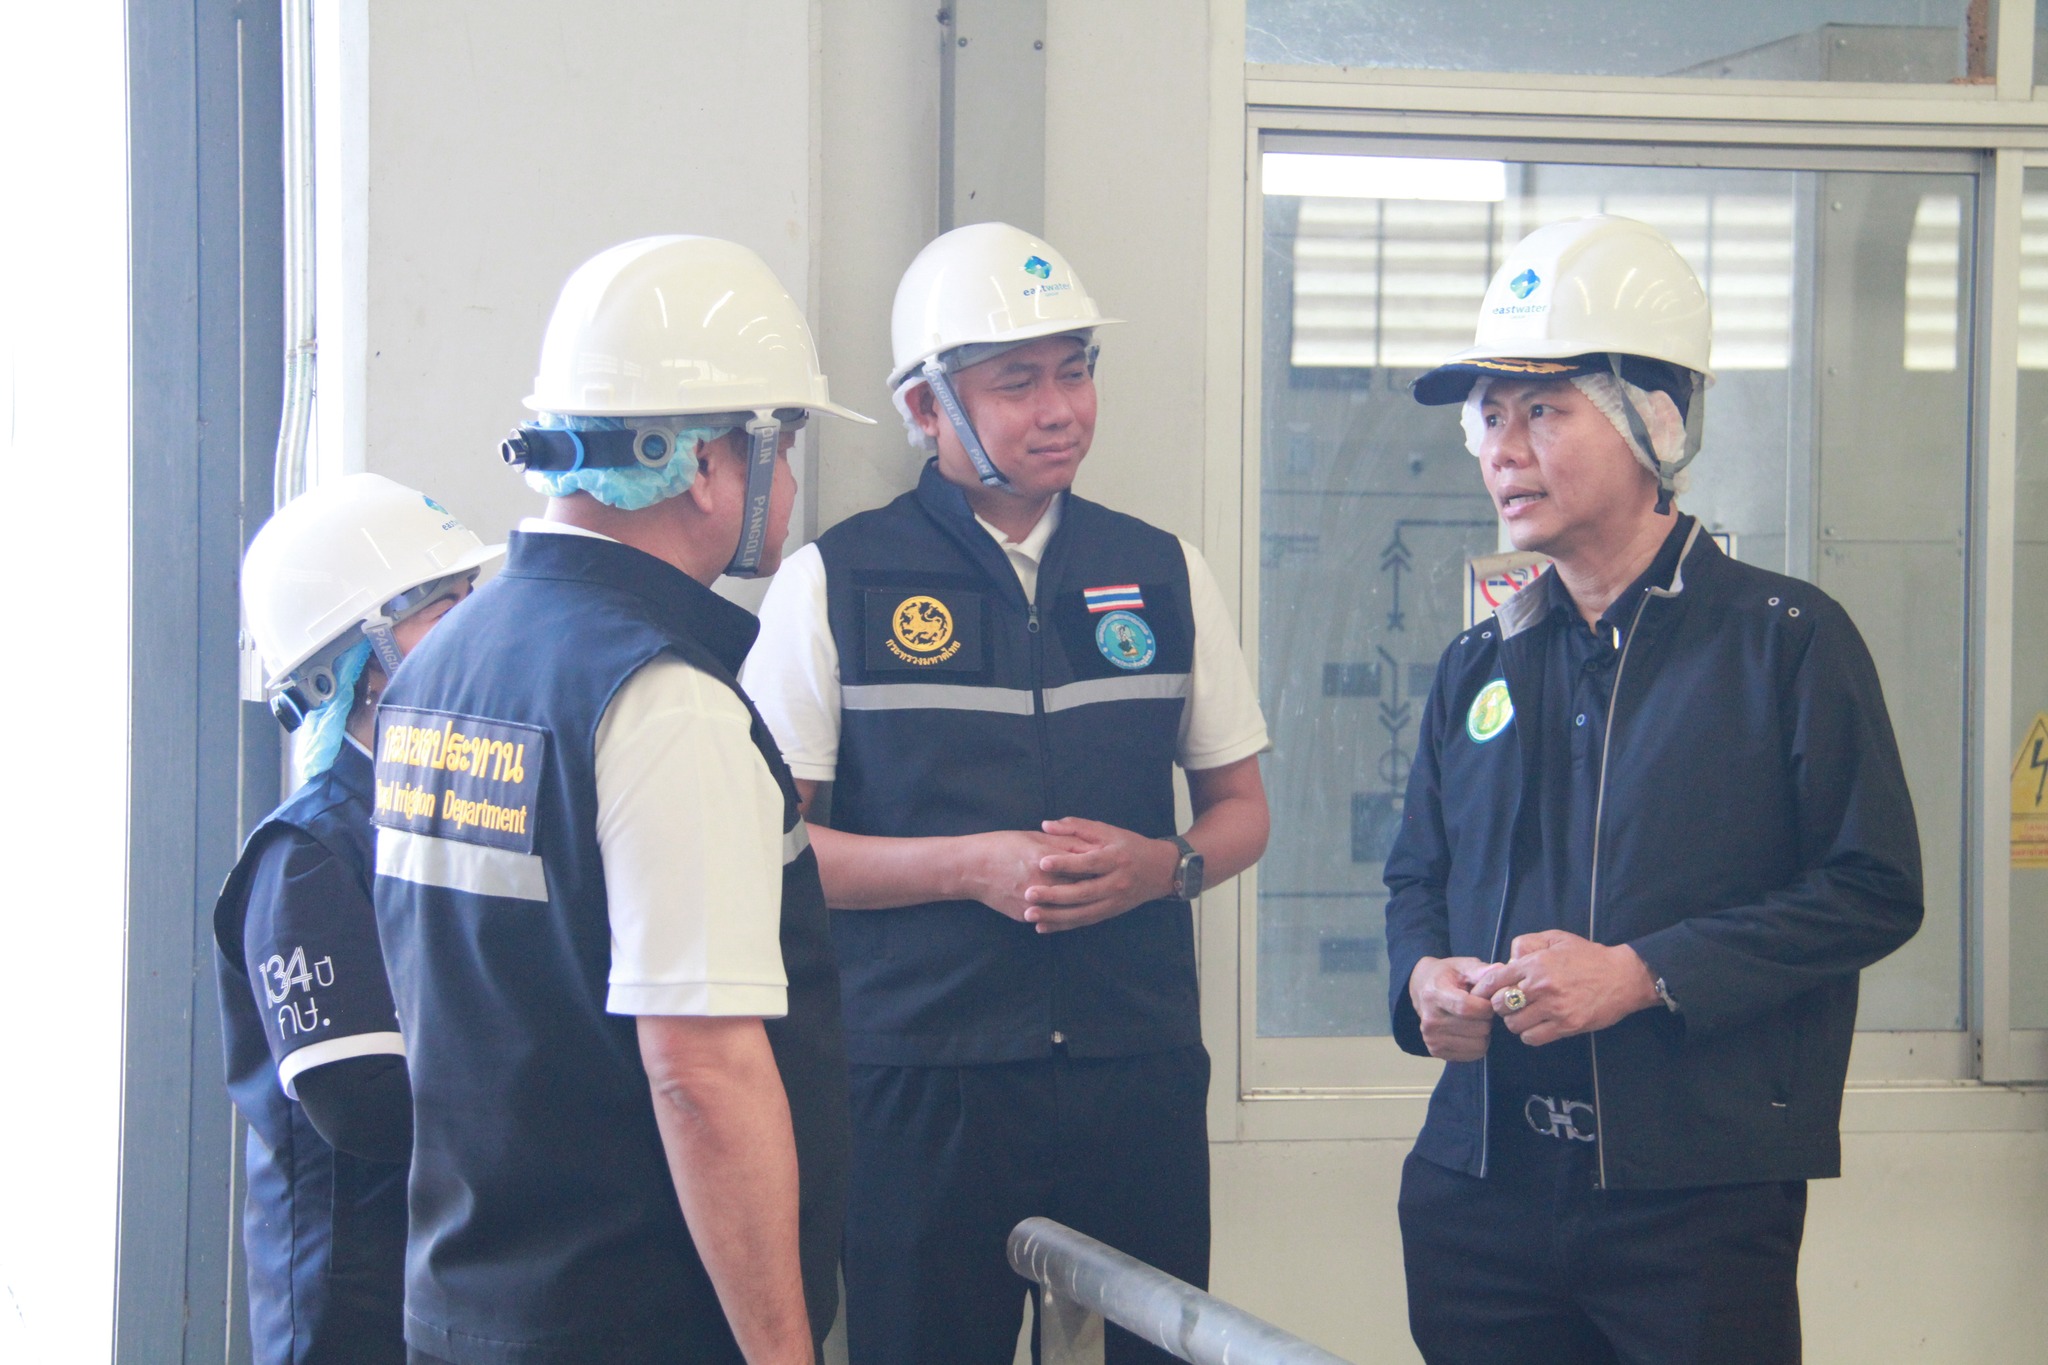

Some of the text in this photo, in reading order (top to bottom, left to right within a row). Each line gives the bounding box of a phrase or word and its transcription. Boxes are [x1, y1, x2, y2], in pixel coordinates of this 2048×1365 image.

[1023, 283, 1071, 296] eatwater
[1492, 304, 1548, 315] eastwater
[885, 638, 962, 666] กระทรวงมหาดไทย
[393, 781, 436, 820] Irrigtion
[442, 790, 527, 834] Department
